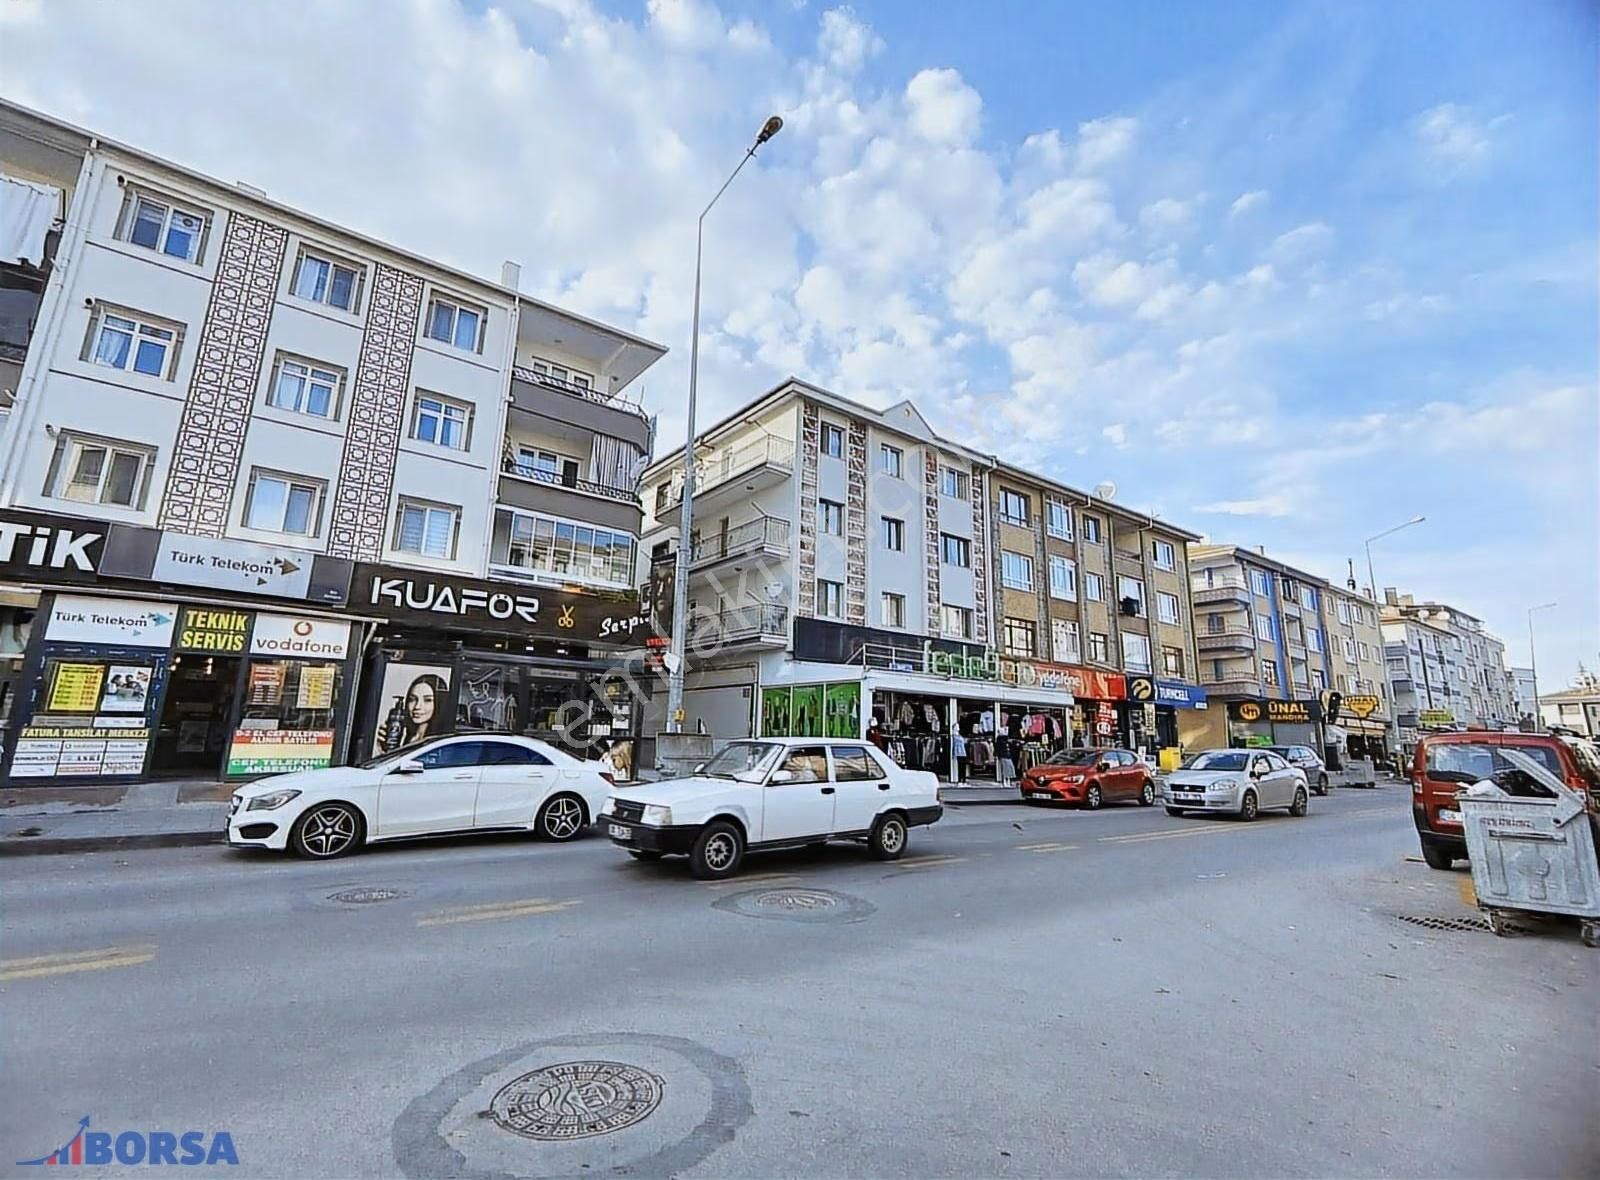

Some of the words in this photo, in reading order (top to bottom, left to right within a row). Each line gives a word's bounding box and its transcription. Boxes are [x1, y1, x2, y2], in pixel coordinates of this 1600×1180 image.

[171, 551, 206, 566] Türk
[211, 556, 274, 575] Telekom
[371, 576, 540, 623] KUAFÖR
[55, 611, 86, 623] Türk
[91, 614, 148, 627] Telekom
[186, 610, 249, 631] TEKNİK
[181, 630, 245, 651] SERVİS
[256, 638, 343, 654] vodafone
[1159, 686, 1190, 701] TURKCELL
[21, 728, 60, 738] FATURA
